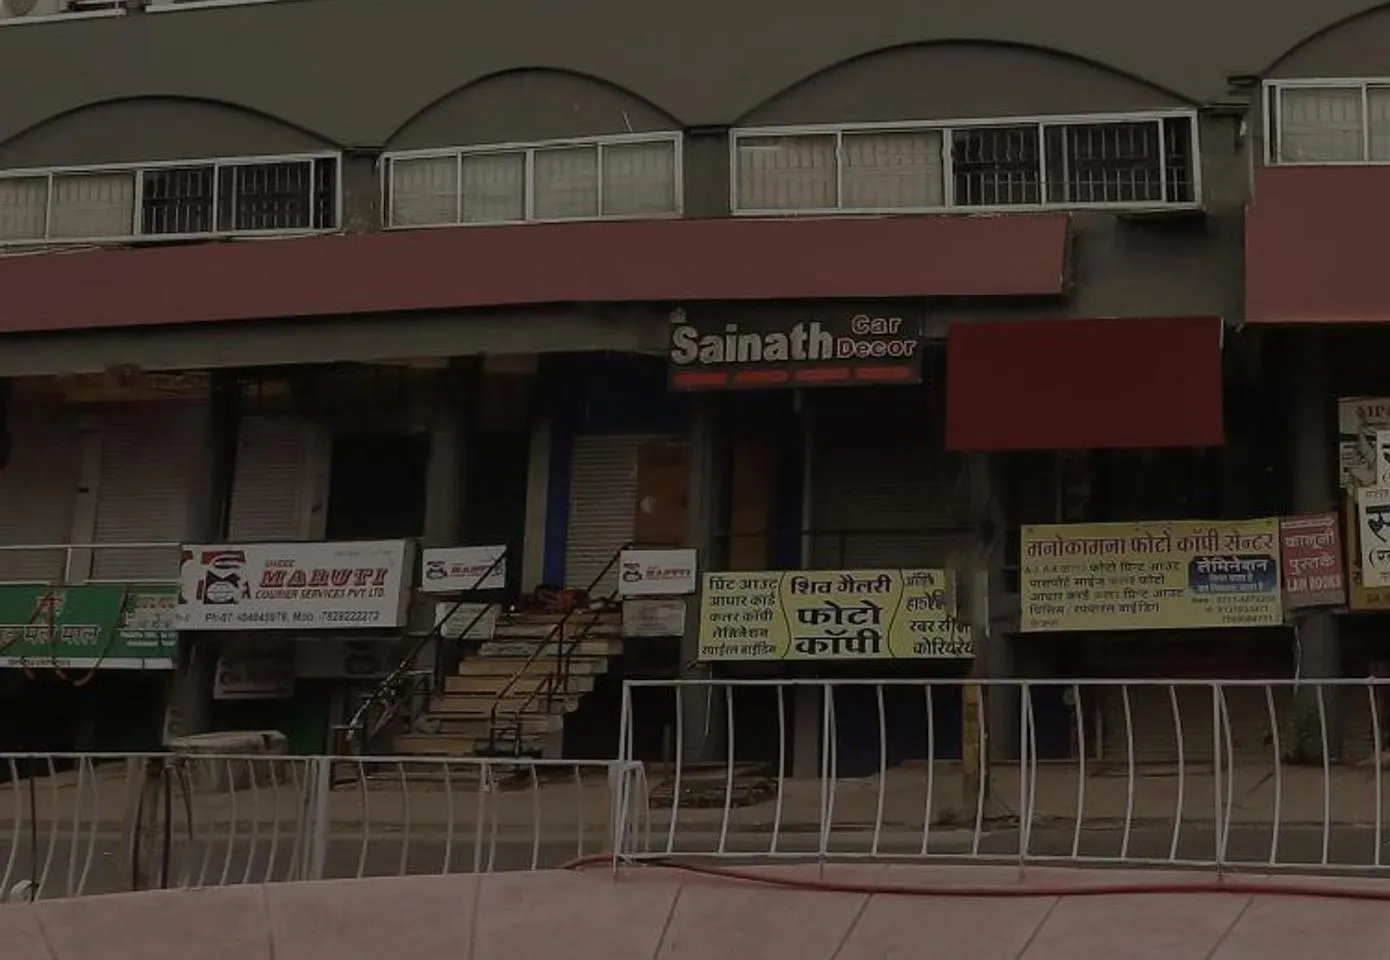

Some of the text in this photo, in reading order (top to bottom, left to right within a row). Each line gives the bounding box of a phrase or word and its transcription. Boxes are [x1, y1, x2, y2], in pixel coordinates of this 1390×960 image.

[851, 314, 902, 336] Car
[670, 321, 833, 365] Sainath
[836, 338, 918, 359] Decor
[1131, 528, 1172, 554] फोटो
[1178, 527, 1219, 553] कॉपी
[259, 568, 389, 588] MARUTI
[791, 576, 833, 595] शिव
[837, 574, 892, 594] गैलरी
[255, 589, 298, 600] COURIER
[299, 588, 346, 599] SERVICES
[347, 588, 366, 598] PVT
[796, 599, 884, 626] फोटो
[793, 628, 884, 655] कॉपी
